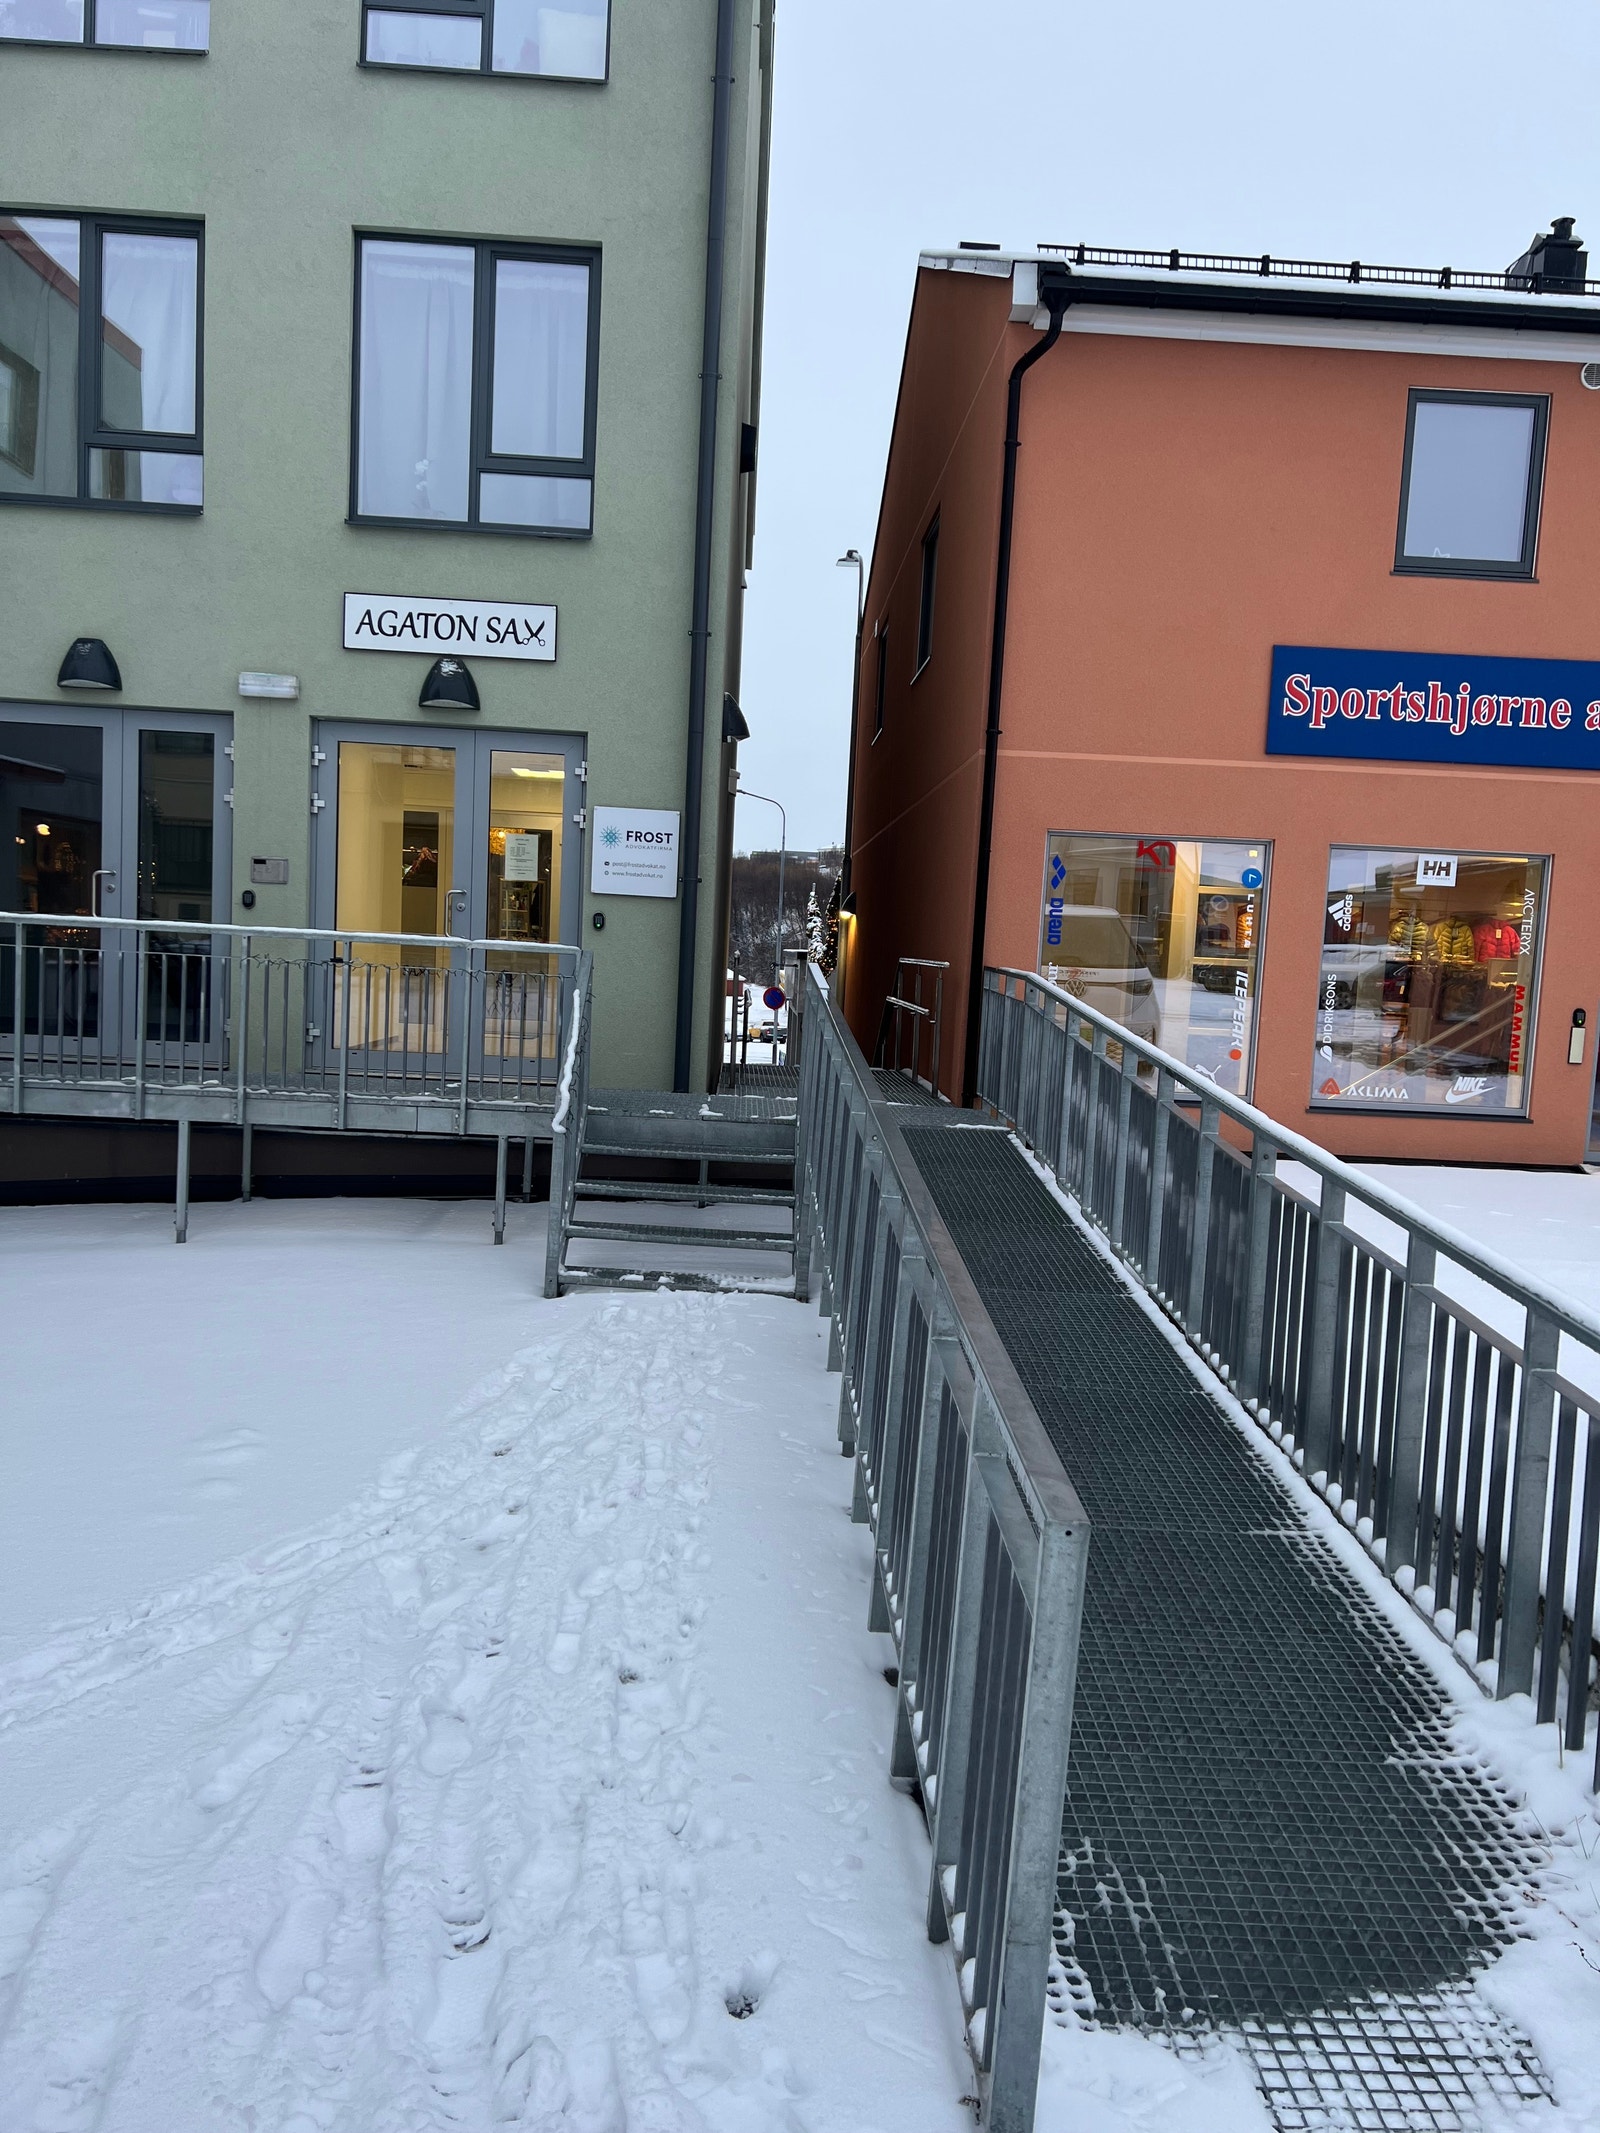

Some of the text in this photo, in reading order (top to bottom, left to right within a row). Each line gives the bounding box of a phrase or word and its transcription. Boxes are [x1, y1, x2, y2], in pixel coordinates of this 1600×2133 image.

[355, 609, 545, 646] AGATON SAX
[1283, 674, 1571, 735] Sportshjørne
[627, 831, 673, 843] FROST
[612, 861, 666, 869] post@frostadvokat.no
[1047, 898, 1063, 945] arena
[1244, 894, 1254, 948] LUHTA
[1343, 894, 1353, 931] adidas
[1231, 970, 1248, 1048] ICEPEAK
[1323, 974, 1337, 1043] DIDRIKSONS
[1509, 985, 1525, 1073] MAMMUT
[1453, 1077, 1487, 1092] NIKE
